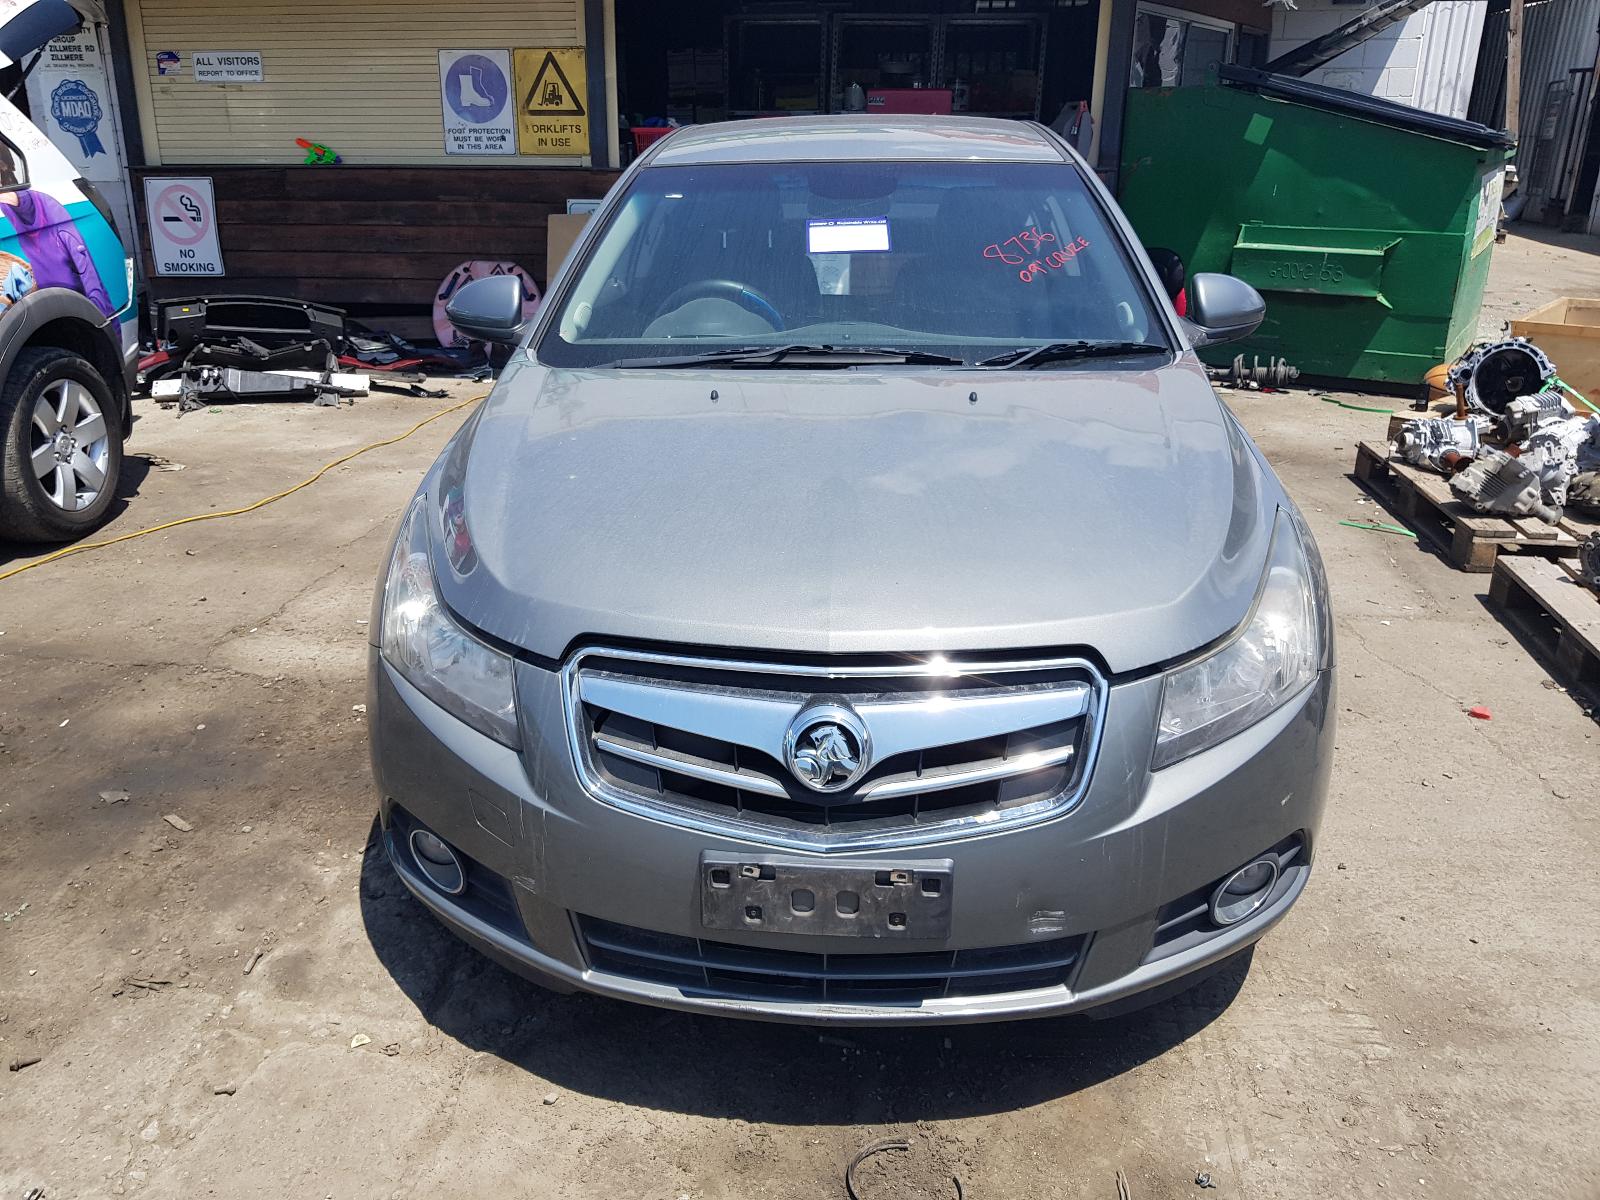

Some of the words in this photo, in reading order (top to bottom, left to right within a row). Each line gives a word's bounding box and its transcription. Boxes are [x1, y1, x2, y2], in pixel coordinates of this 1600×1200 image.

[85, 44, 95, 52] RD
[196, 57, 214, 66] ALL
[217, 56, 260, 66] VISITORS
[447, 127, 466, 135] FOOT
[468, 127, 511, 135] PROTECTION
[538, 138, 548, 147] IN
[551, 137, 571, 147] USE
[179, 249, 195, 259] NO
[164, 262, 215, 272] SMOKING
